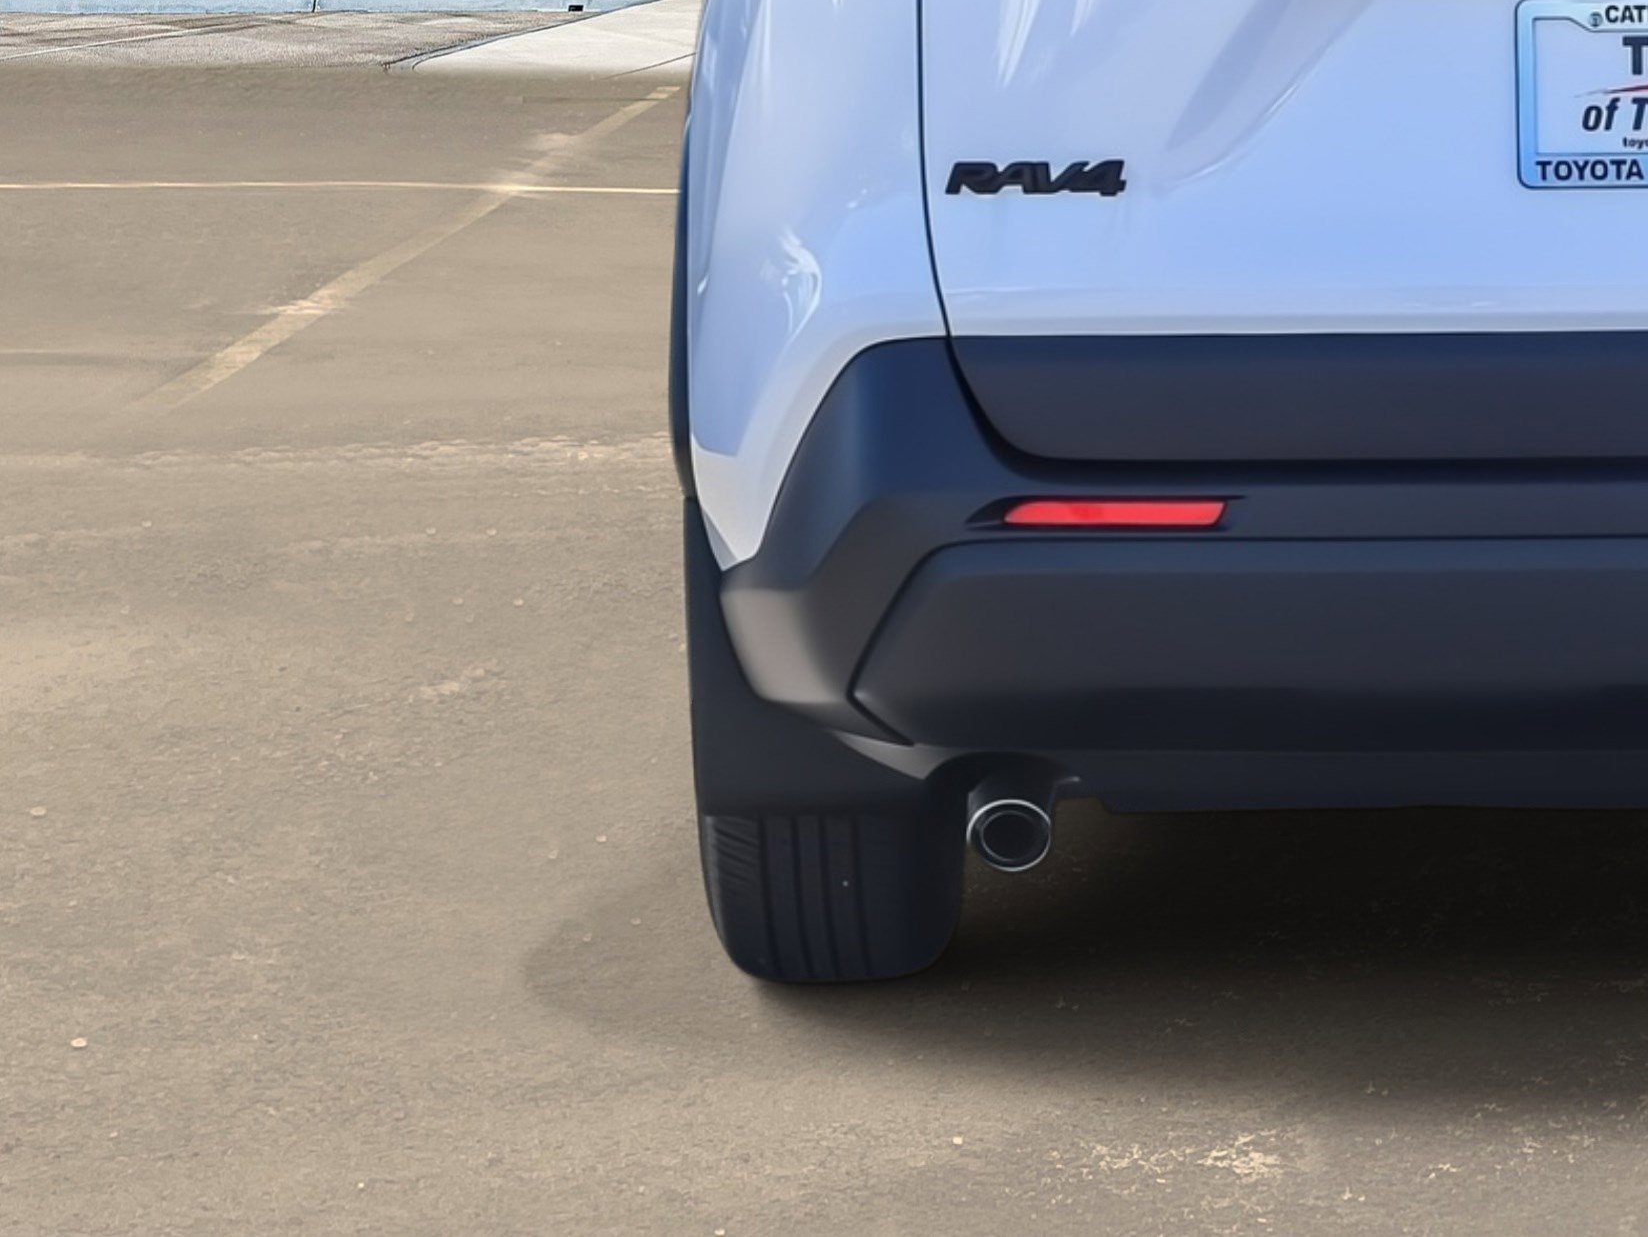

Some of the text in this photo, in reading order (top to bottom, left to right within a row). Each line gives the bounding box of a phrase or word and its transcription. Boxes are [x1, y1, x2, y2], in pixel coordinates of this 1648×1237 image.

[1581, 97, 1621, 132] of
[945, 160, 1127, 196] RAV4
[1535, 158, 1645, 181] TOYOTA
